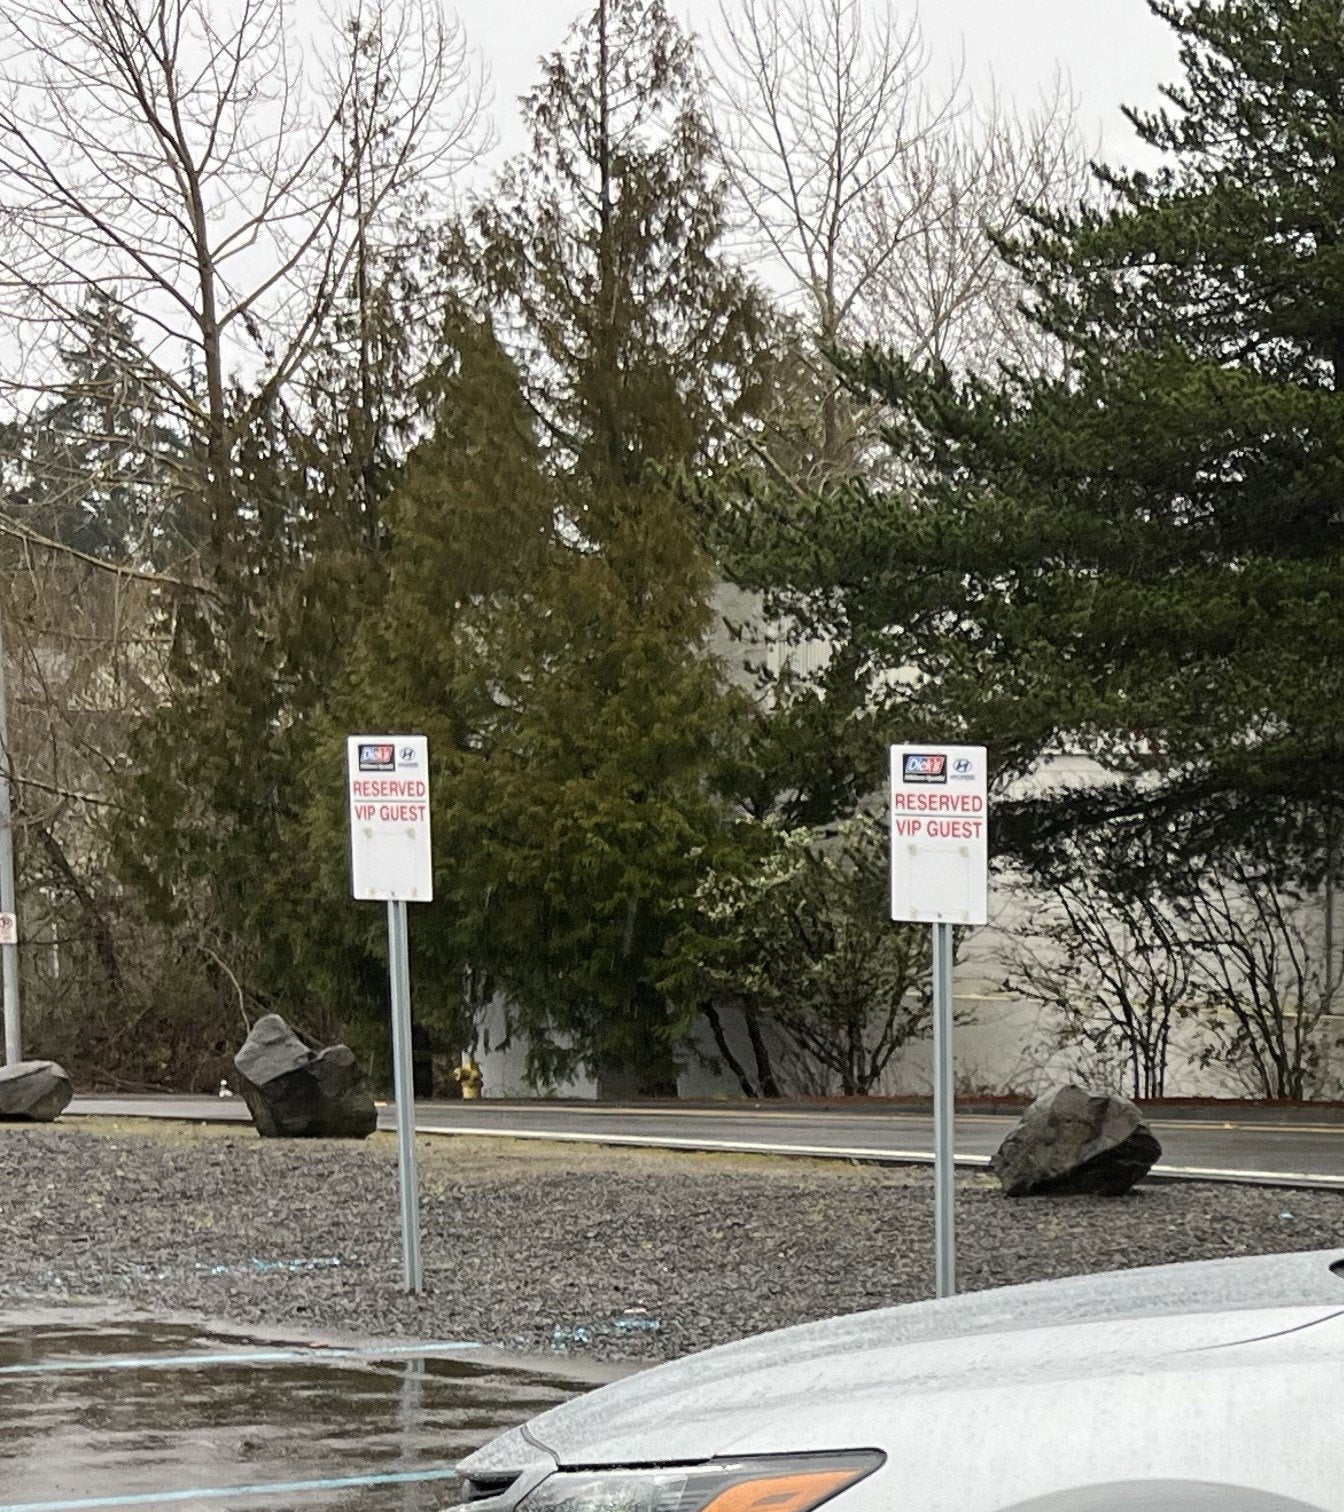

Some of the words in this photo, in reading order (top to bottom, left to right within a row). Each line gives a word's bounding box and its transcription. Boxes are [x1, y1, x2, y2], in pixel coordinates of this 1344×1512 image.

[353, 781, 426, 797] RESERVED
[895, 793, 983, 812] RESERVED
[354, 805, 376, 821] VIP
[380, 805, 426, 822] GUEST
[896, 820, 922, 836] VIP
[927, 820, 982, 839] GUEST
